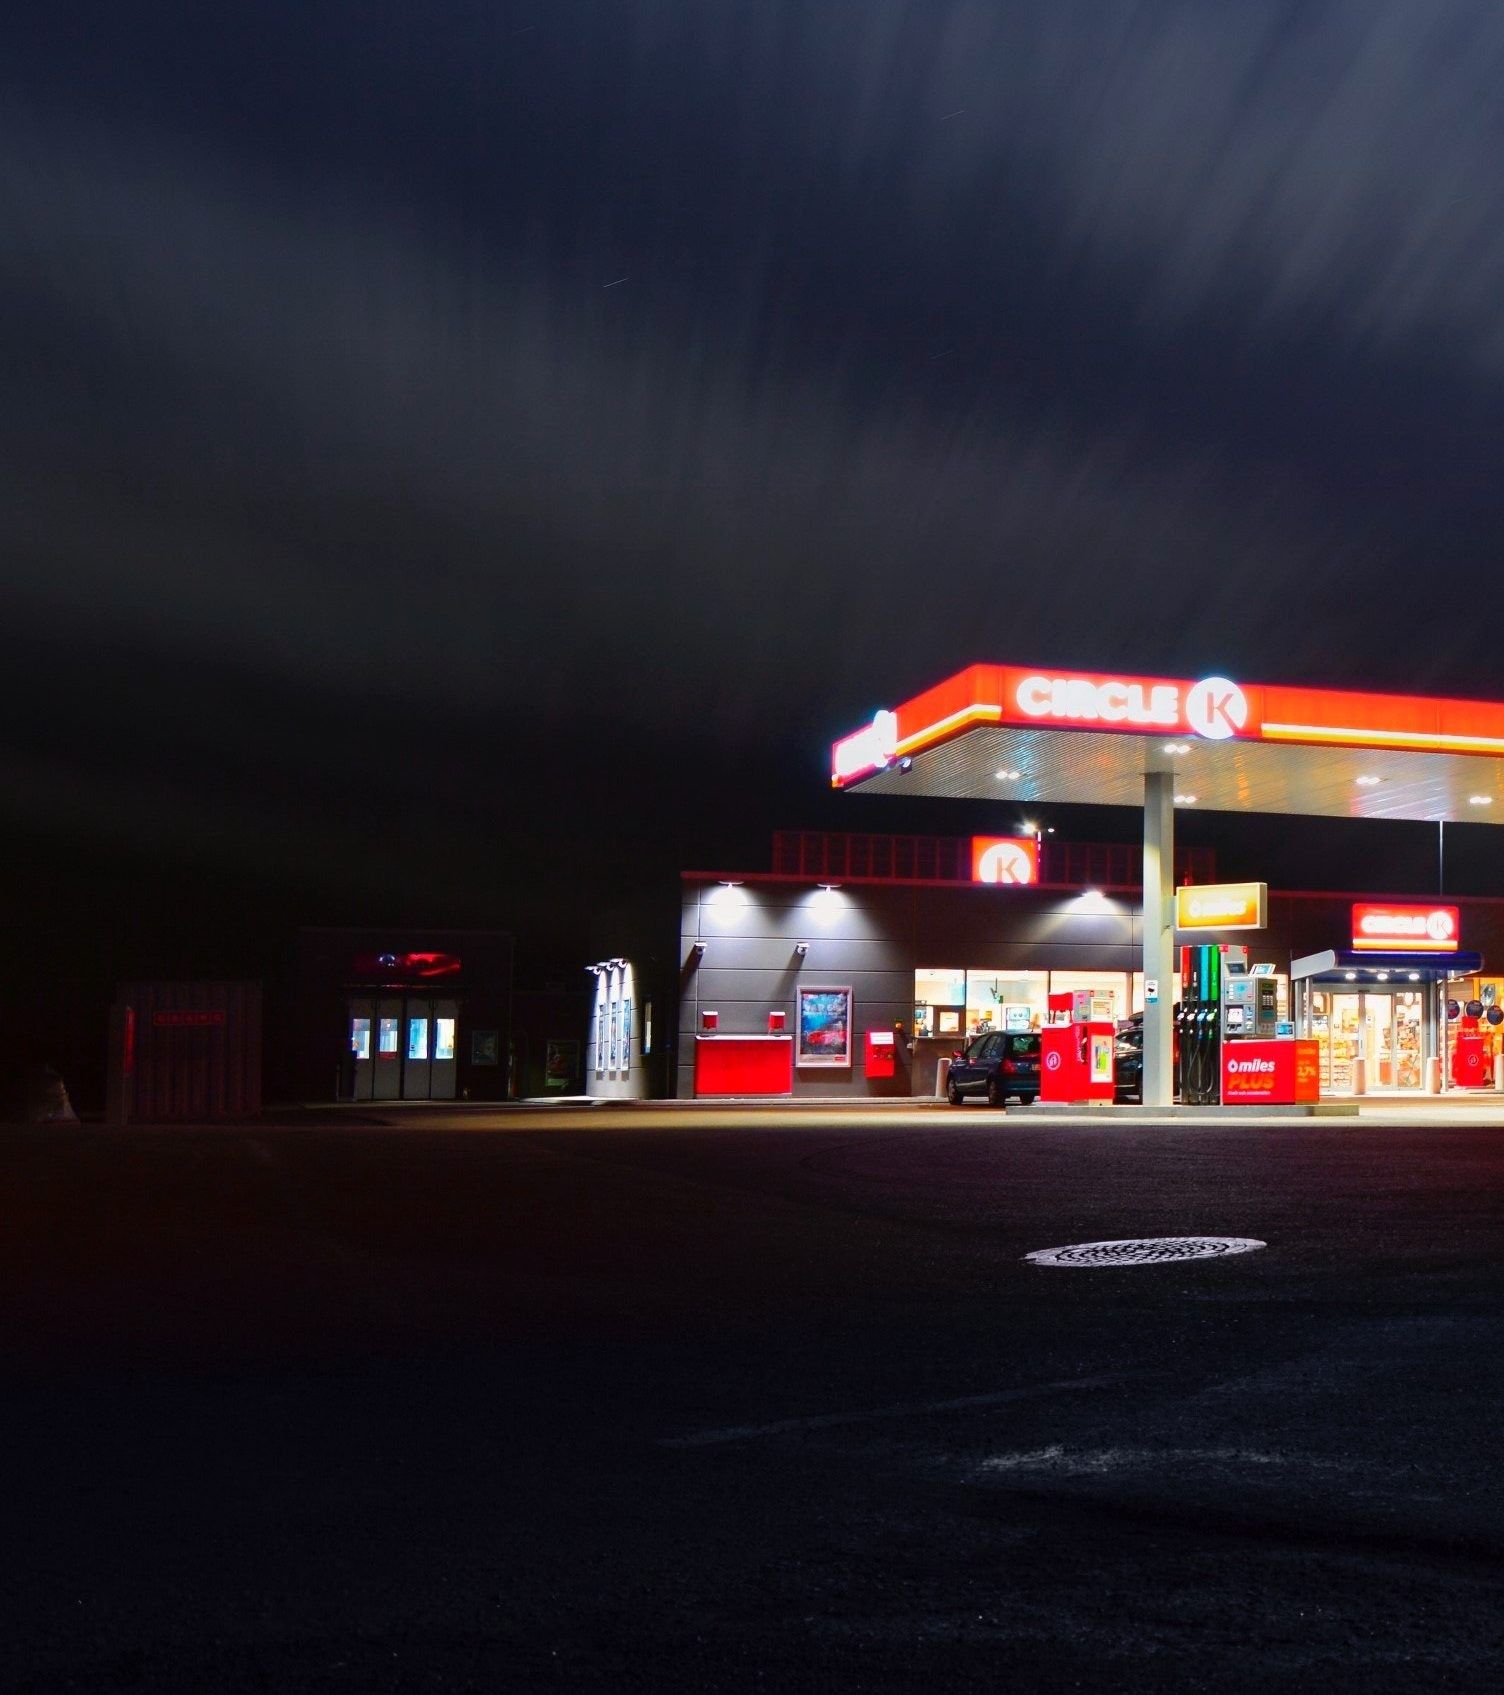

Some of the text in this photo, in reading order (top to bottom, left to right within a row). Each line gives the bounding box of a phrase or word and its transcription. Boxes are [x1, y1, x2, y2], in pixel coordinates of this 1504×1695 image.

[1016, 676, 1244, 736] CIRCLE K
[1237, 1058, 1275, 1073] miles
[1228, 1073, 1275, 1089] PLUS
